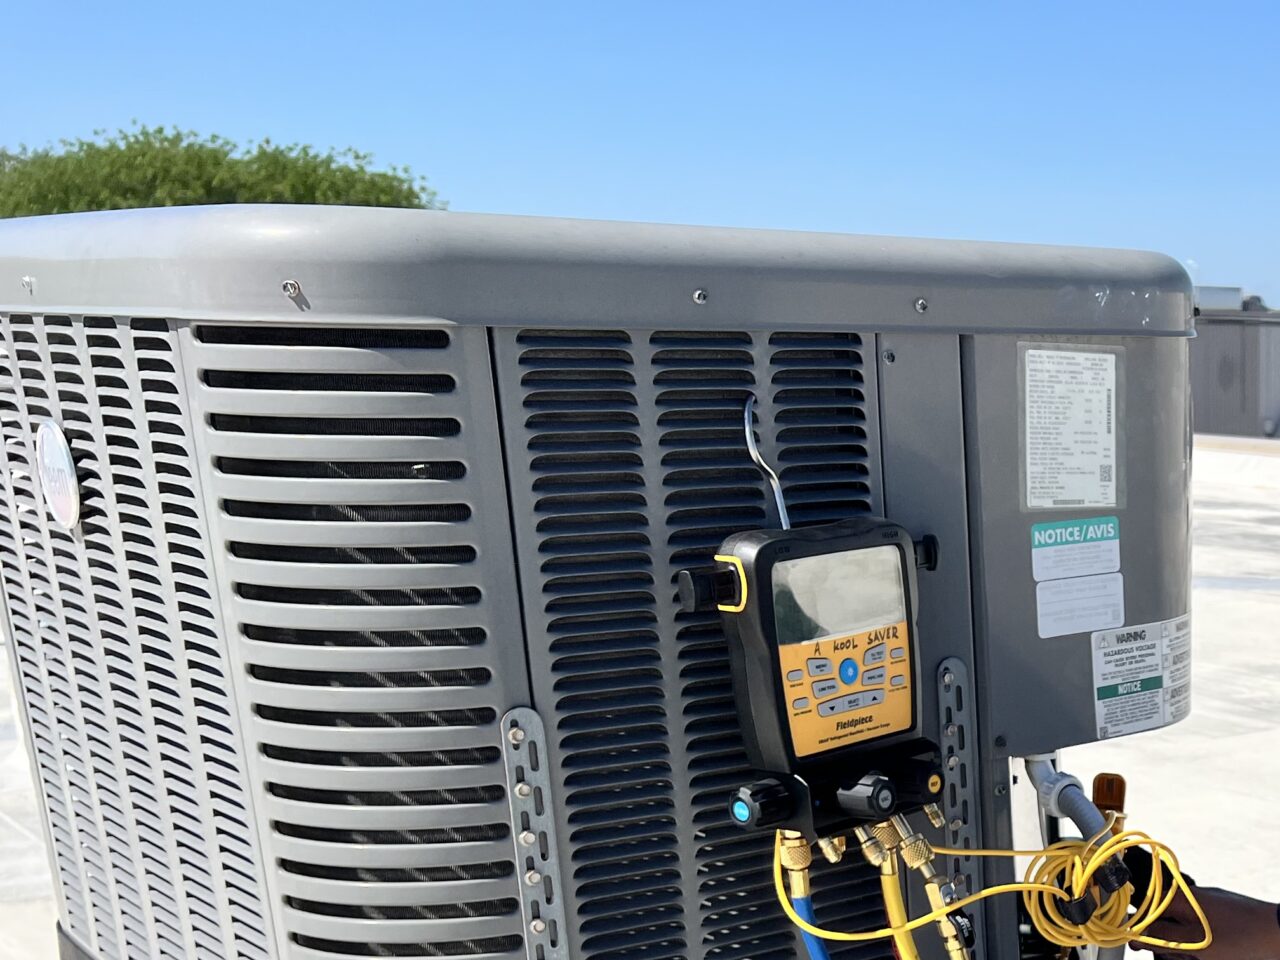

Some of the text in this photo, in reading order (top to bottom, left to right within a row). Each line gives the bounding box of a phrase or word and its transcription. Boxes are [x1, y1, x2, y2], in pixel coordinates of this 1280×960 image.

[1034, 523, 1115, 545] NOTICE/AVIS
[814, 641, 822, 656] A
[867, 626, 899, 645] SAVER
[1115, 629, 1147, 644] WARNING
[1118, 680, 1142, 695] NOTICE
[836, 715, 874, 731] Fieldpiece
